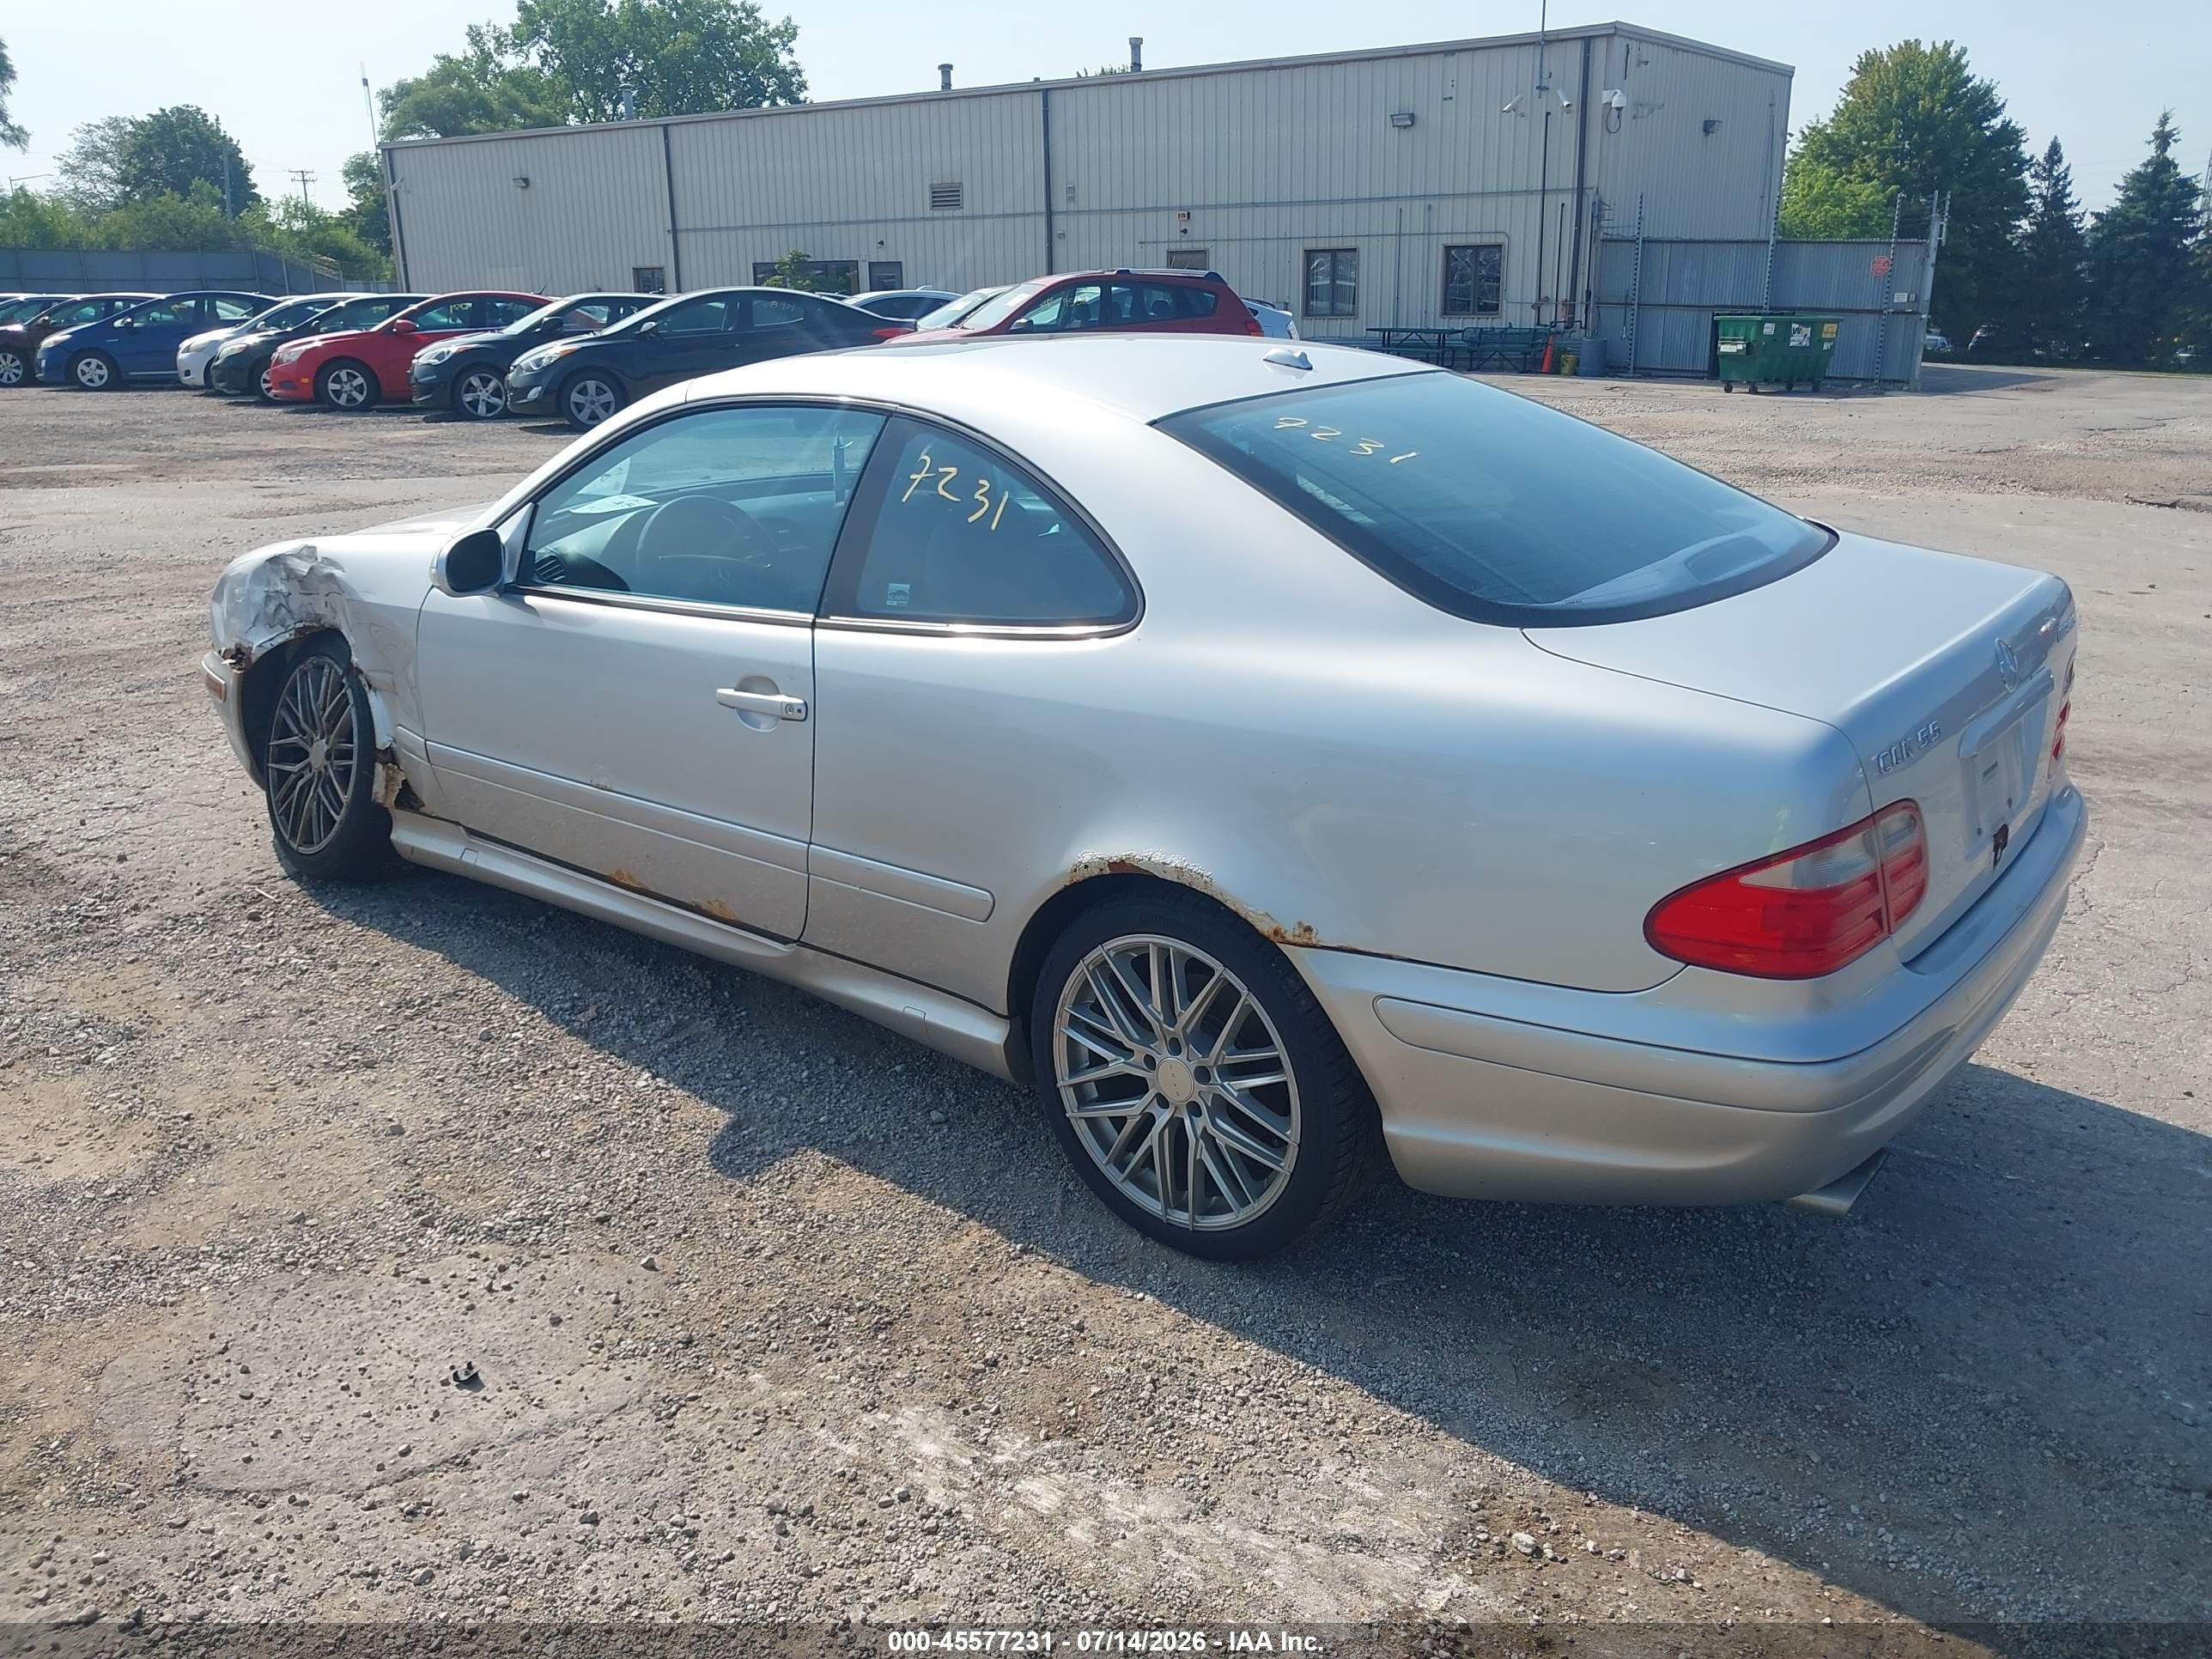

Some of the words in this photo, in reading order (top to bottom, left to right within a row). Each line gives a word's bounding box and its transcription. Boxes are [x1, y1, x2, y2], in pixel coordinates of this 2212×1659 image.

[1273, 417, 1419, 464] 7231
[901, 454, 1009, 531] 7231
[1878, 738, 1913, 774] CLK
[1917, 720, 1942, 750] 55
